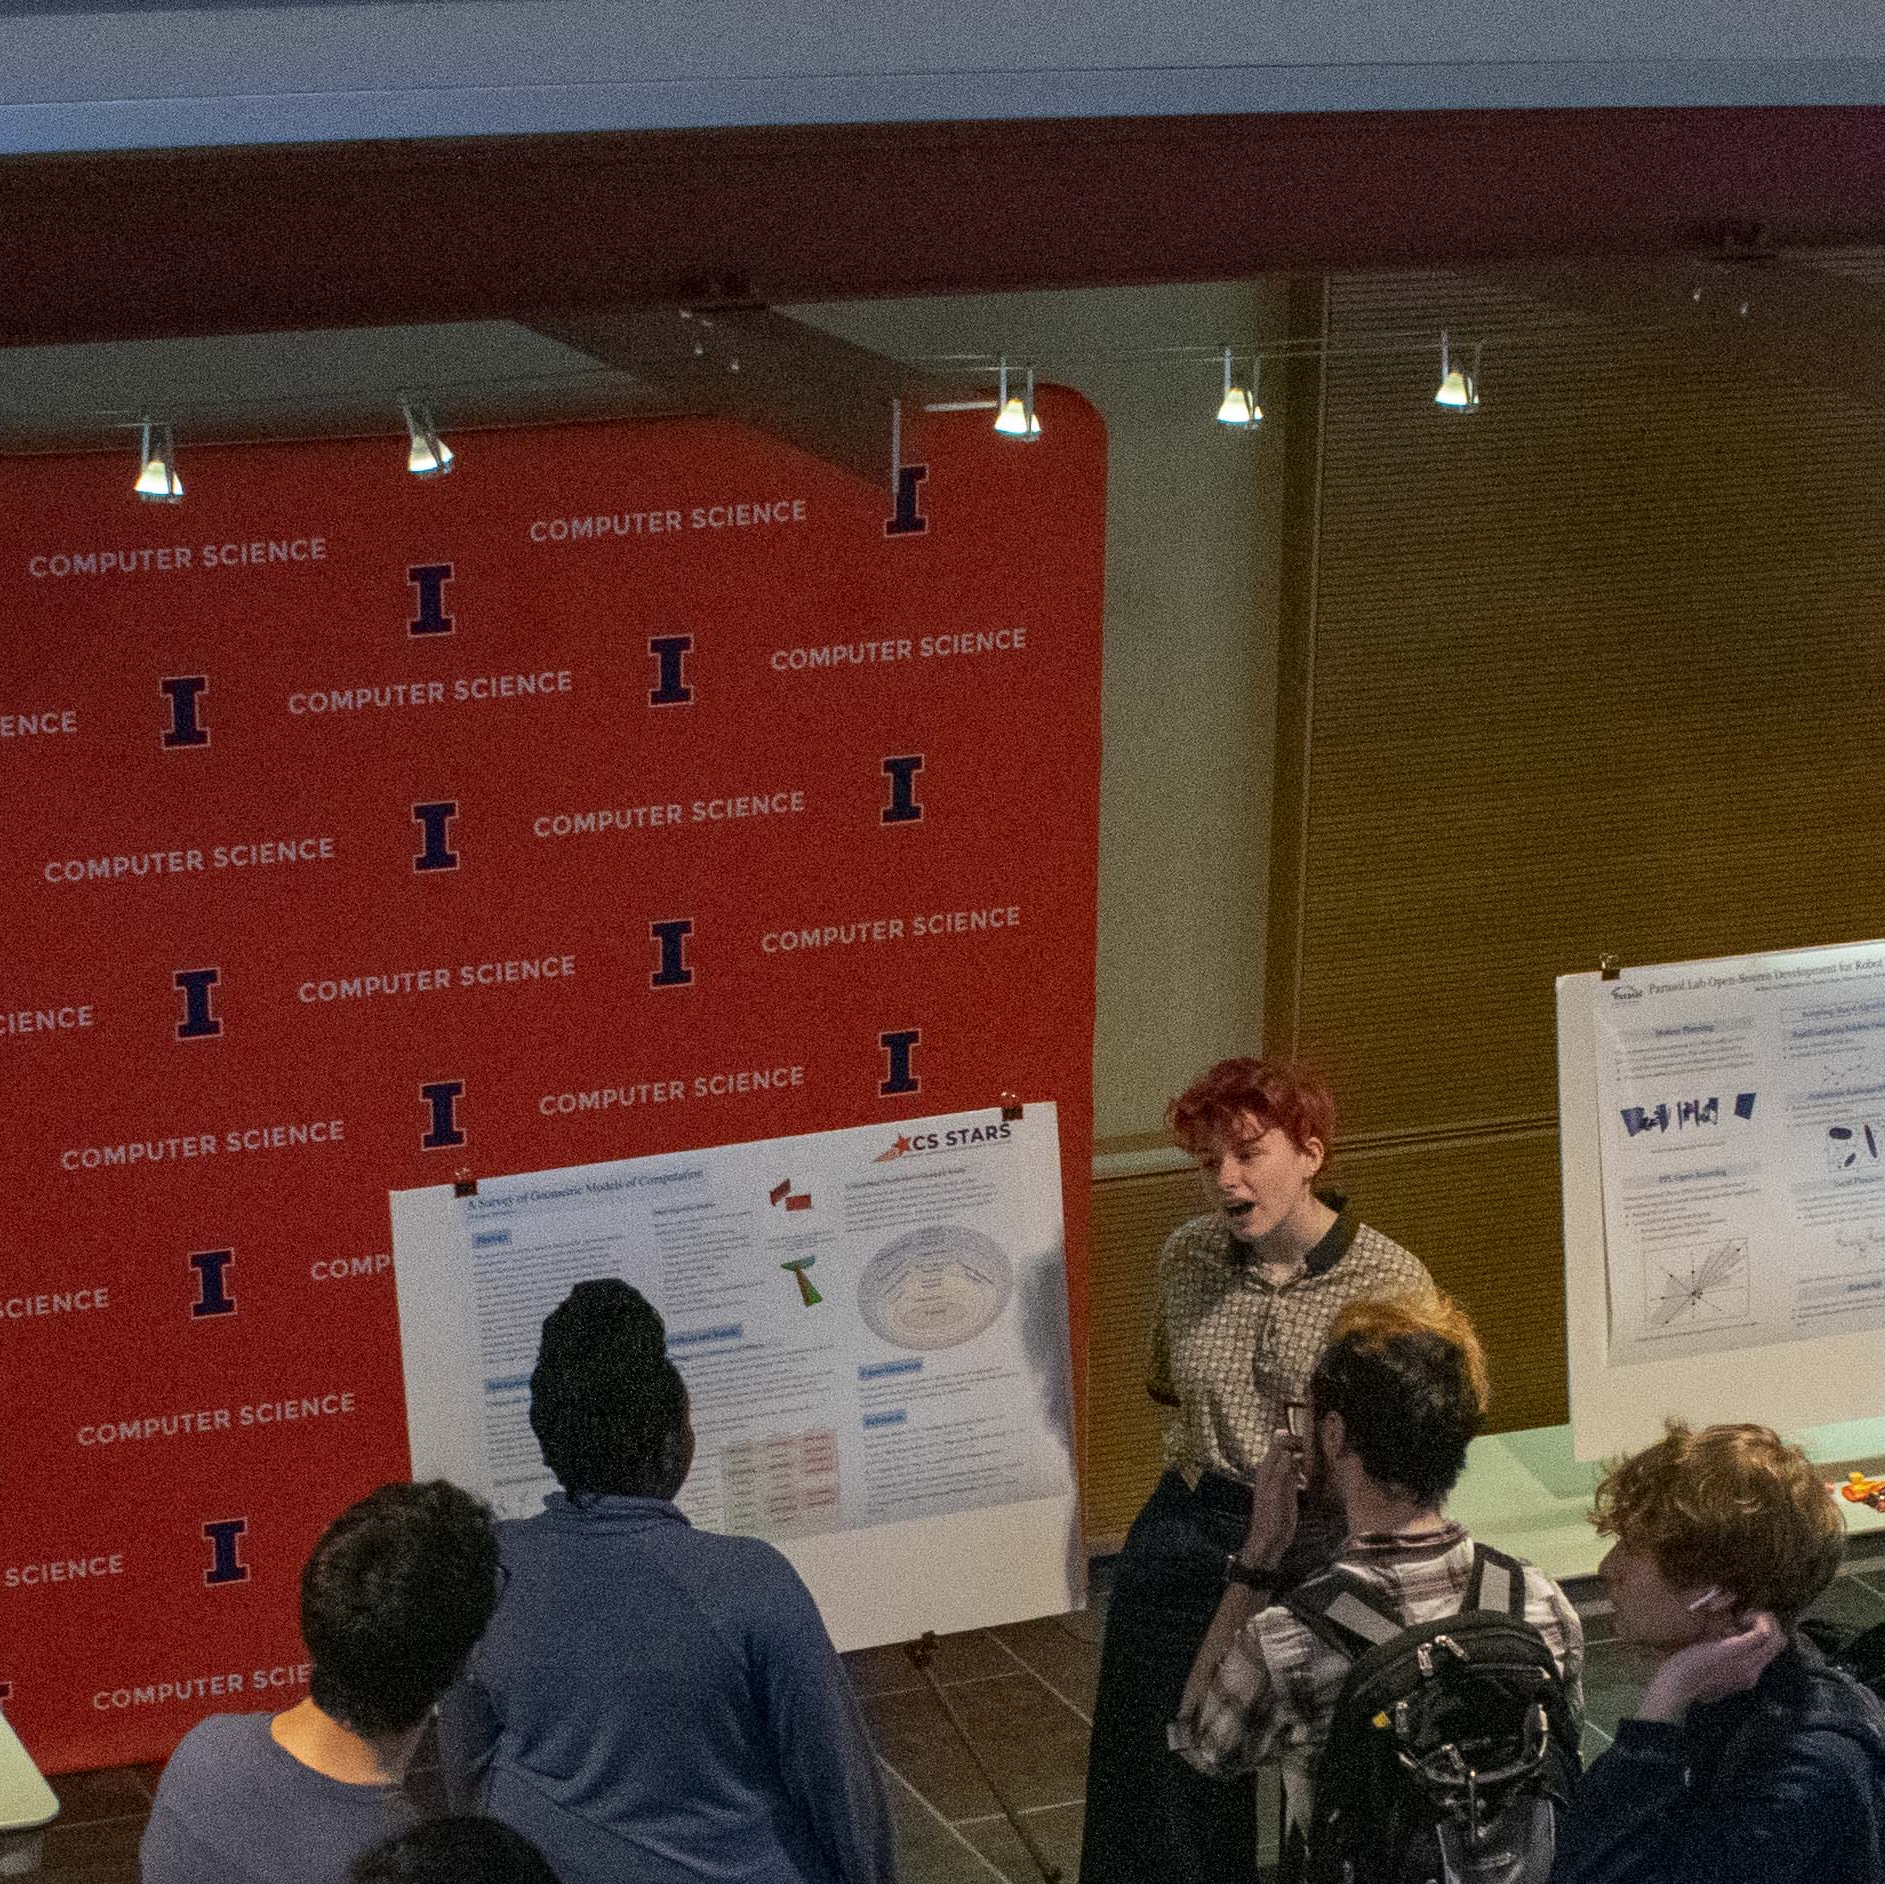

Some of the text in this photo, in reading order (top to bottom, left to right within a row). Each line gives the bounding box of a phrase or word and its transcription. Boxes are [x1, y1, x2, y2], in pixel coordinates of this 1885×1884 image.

[529, 500, 808, 543] COMPUTER SCIENCE
[29, 538, 327, 578] COMPUTER SCIENCE
[771, 628, 1027, 671] COMPUTER SCIENCE
[288, 670, 573, 716] COMPUTER SCIENCE
[533, 792, 805, 838] COMPUTER SCIENCE
[43, 838, 336, 883] COMPUTER SCIENCE
[761, 907, 1021, 954] COMPUTER SCIENCE
[298, 955, 576, 1004] COMPUTER SCIENCE
[538, 1066, 805, 1117] COMPUTER SCIENCE
[61, 1121, 345, 1171] COMPUTER SCIENCE
[912, 1123, 1012, 1151] CS STARS
[77, 1393, 356, 1447] COMPUTER SCIENCE
[4, 1554, 125, 1587] SCIENCE
[92, 1662, 312, 1712] COMPUTER SCIE
